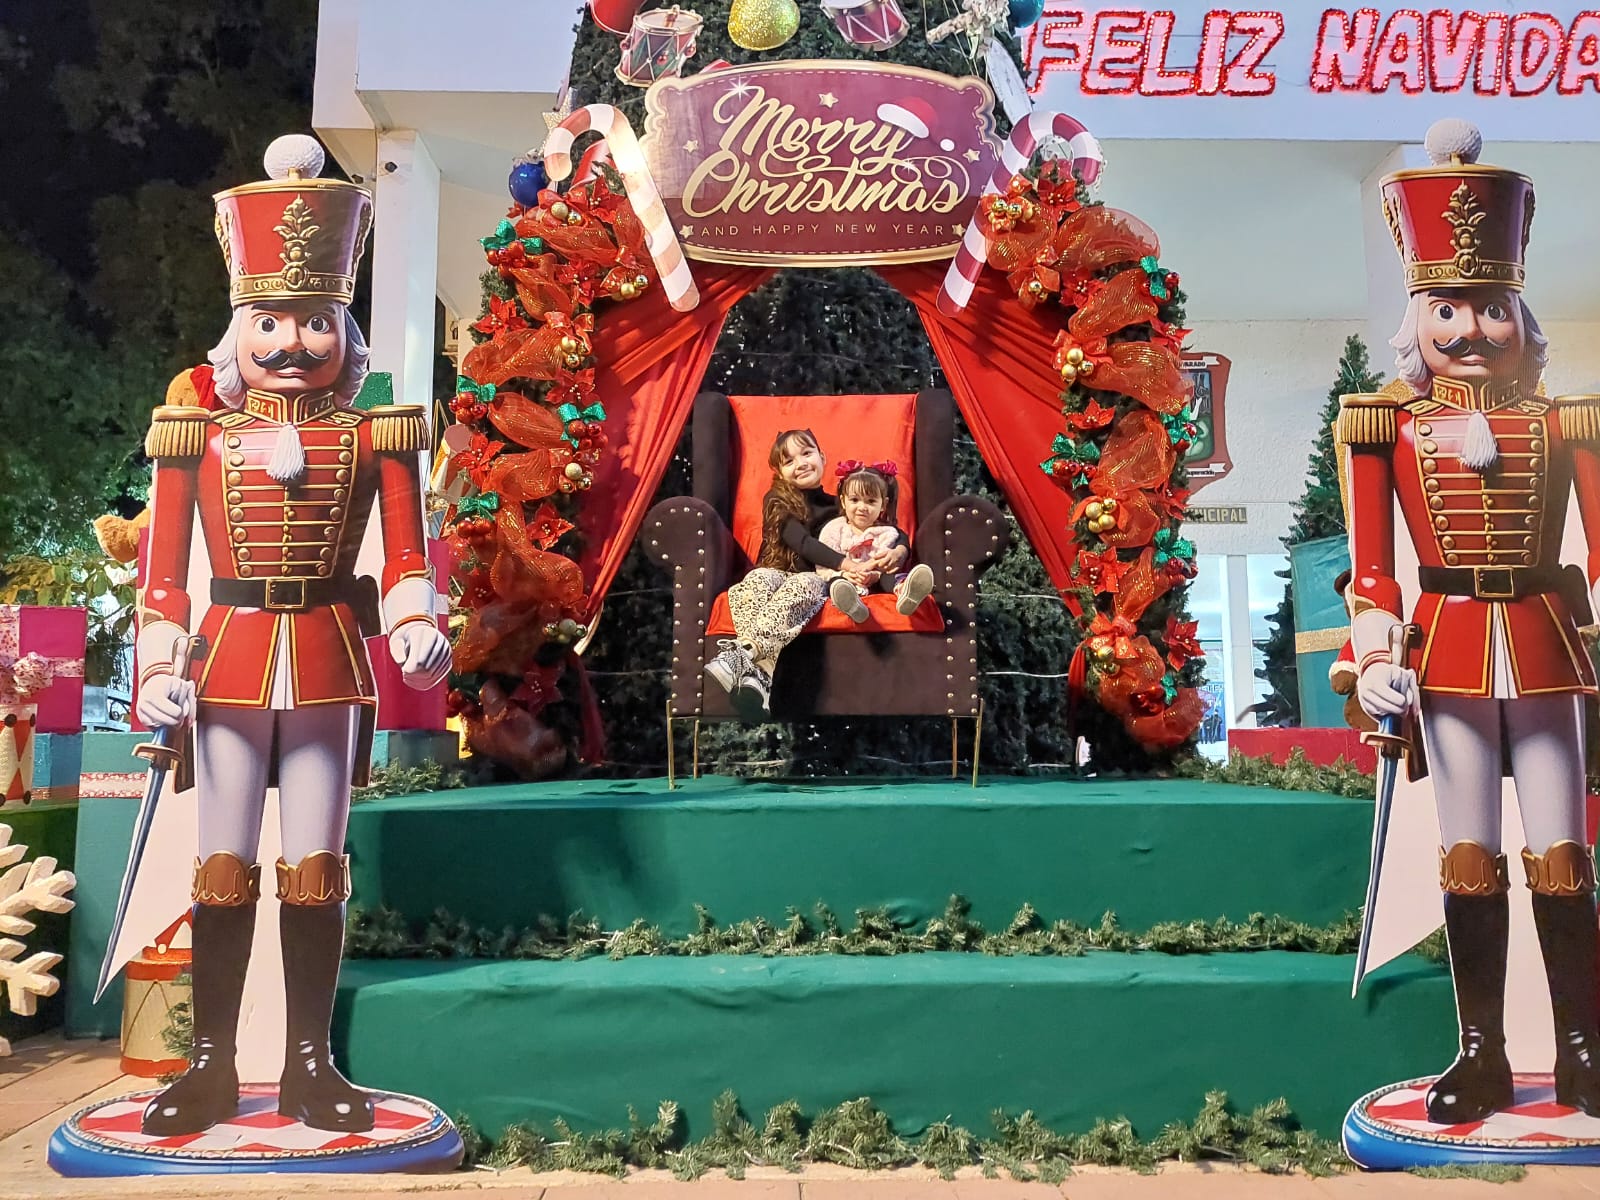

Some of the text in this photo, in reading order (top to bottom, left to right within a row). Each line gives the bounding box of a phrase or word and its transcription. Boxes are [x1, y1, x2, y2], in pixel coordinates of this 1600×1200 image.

[1024, 8, 1600, 97] FELIZ NAVIDA
[713, 86, 916, 176] Merry
[682, 150, 968, 218] Christmas
[701, 223, 943, 236] AND HAPPY NEW YEAR
